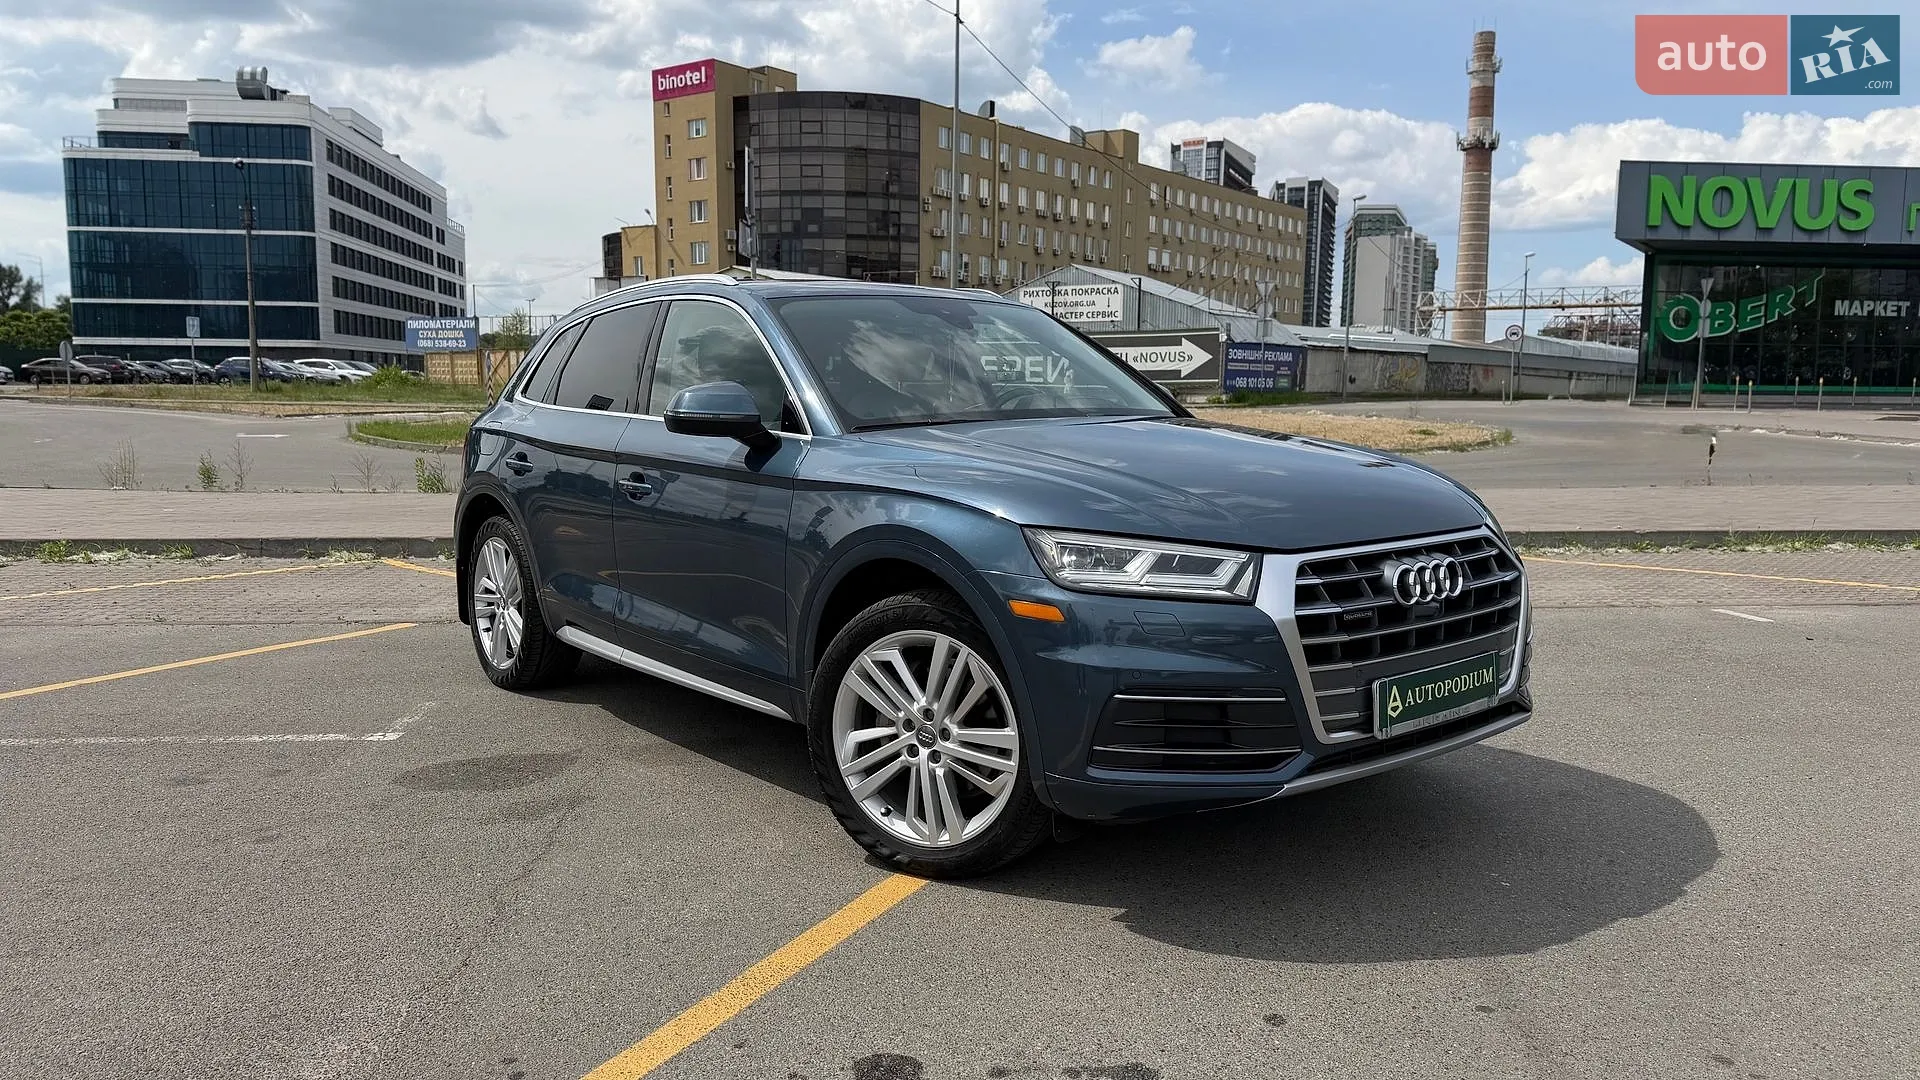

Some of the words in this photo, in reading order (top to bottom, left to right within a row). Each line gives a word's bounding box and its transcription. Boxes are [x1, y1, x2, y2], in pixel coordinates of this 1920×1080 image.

[657, 65, 707, 91] binotel
[1647, 174, 1876, 232] NOVUS
[1023, 288, 1069, 299] РИХТОВКА
[1071, 286, 1119, 297] ПОКРАСКА
[1086, 310, 1119, 319] СЕРВИС
[1834, 299, 1911, 317] МАРКЕТ
[407, 319, 476, 329] ПИЛОМАТЕРІАЛИ
[418, 330, 437, 338] СУХА
[438, 330, 464, 339] ДОШКА
[1132, 351, 1194, 364] «NOVUS»
[1264, 350, 1293, 362] РЕКЛАМА
[1405, 666, 1494, 707] AUTOPODIUM
